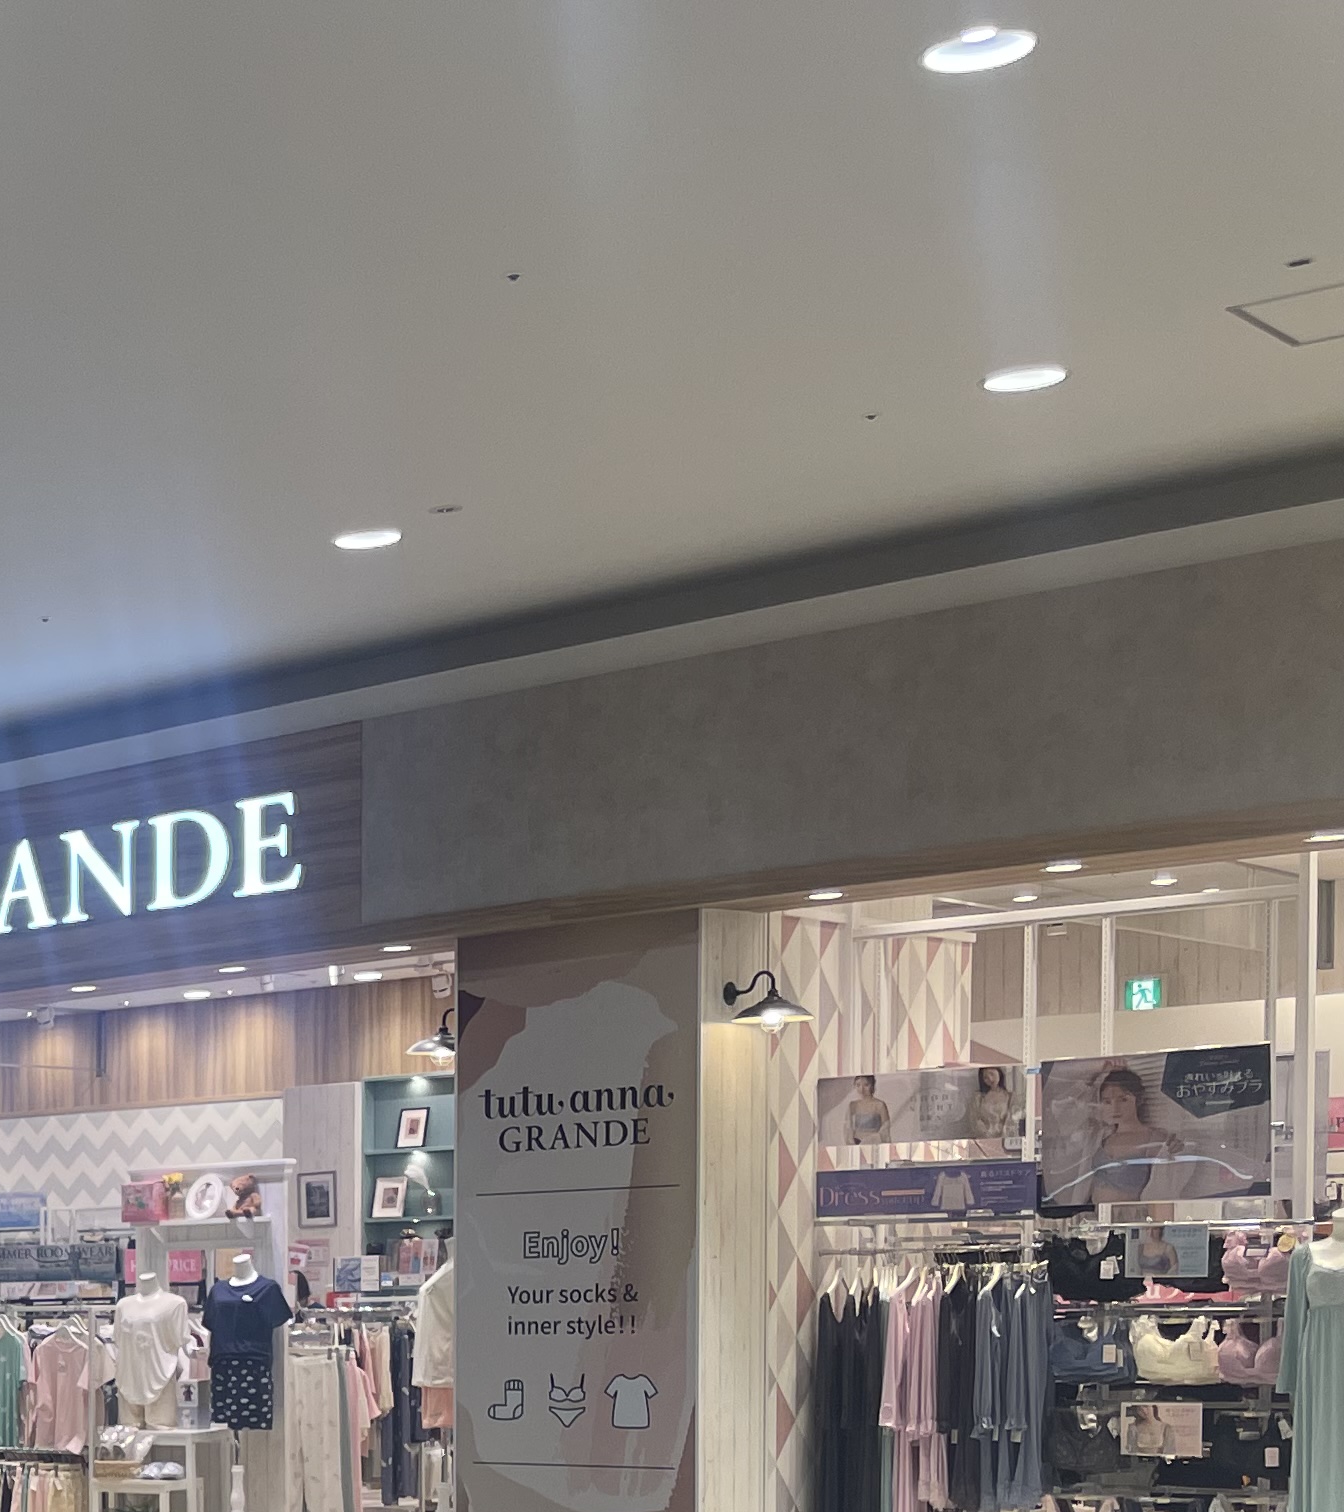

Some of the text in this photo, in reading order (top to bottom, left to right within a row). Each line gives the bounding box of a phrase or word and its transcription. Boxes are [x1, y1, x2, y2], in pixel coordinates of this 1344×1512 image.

[1176, 1078, 1263, 1098] おやすみブラ
[477, 1083, 675, 1120] tutu anna
[498, 1117, 651, 1153] GRANDE
[819, 1186, 880, 1207] Dress
[522, 1228, 620, 1266] Enjoy!
[507, 1283, 639, 1305] Your socks &
[507, 1314, 637, 1340] inner style!!
